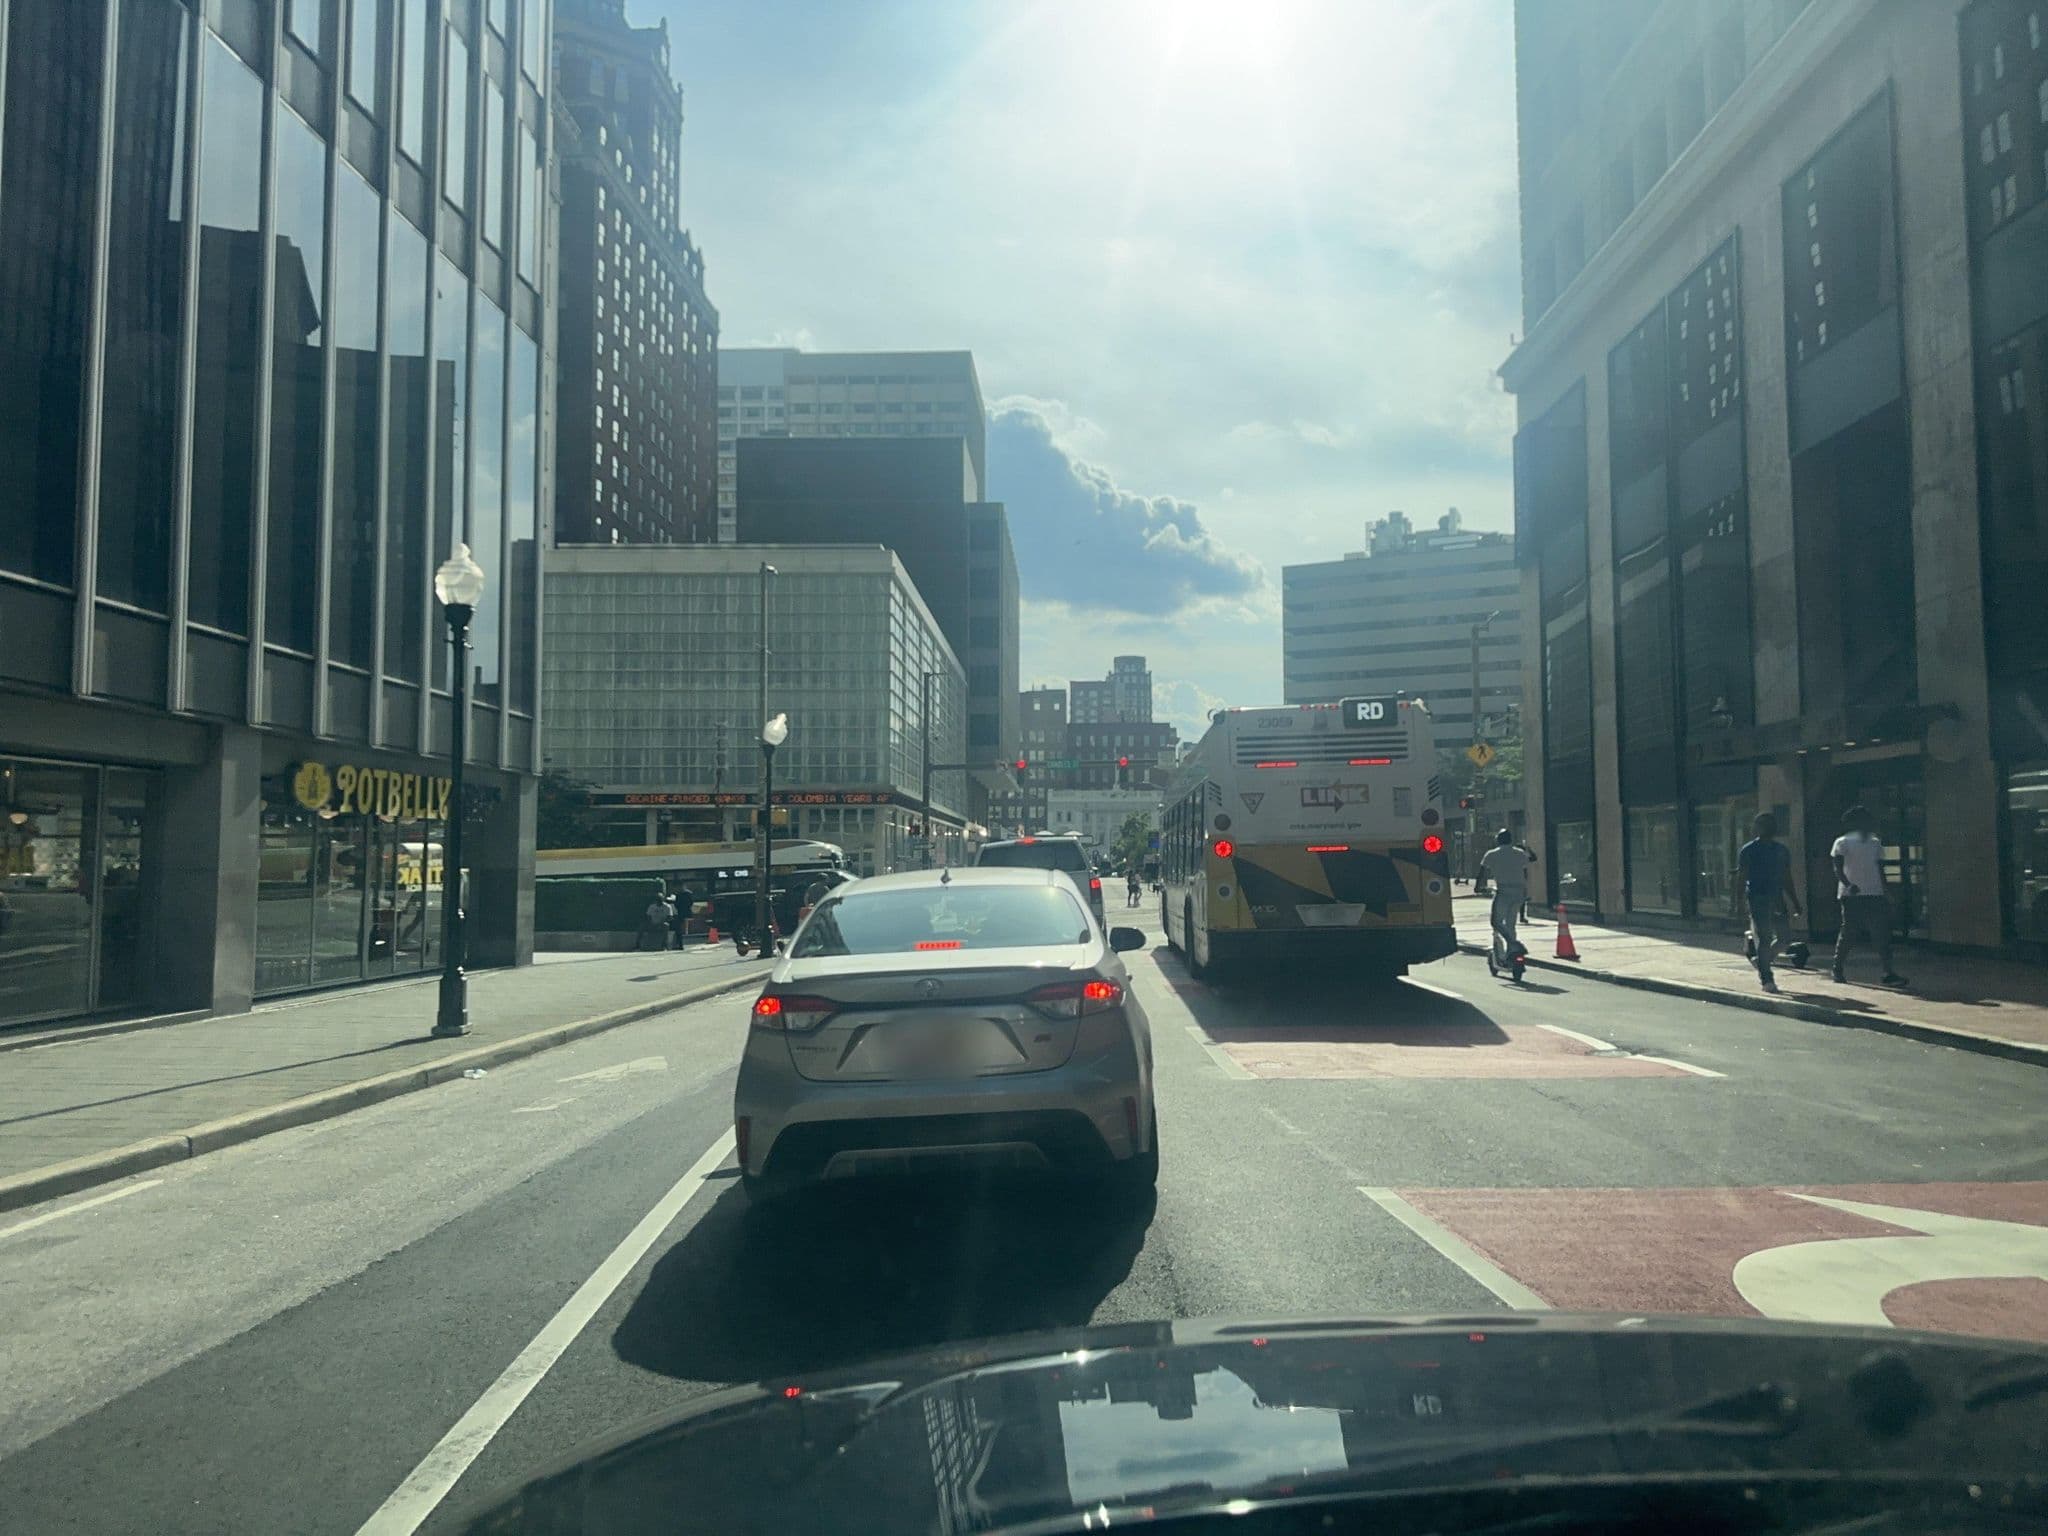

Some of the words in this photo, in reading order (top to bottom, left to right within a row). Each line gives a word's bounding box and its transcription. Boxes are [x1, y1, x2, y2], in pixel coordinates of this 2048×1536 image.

[1357, 702, 1384, 720] RD
[336, 764, 452, 820] POTBELLY
[1303, 785, 1369, 804] LINK
